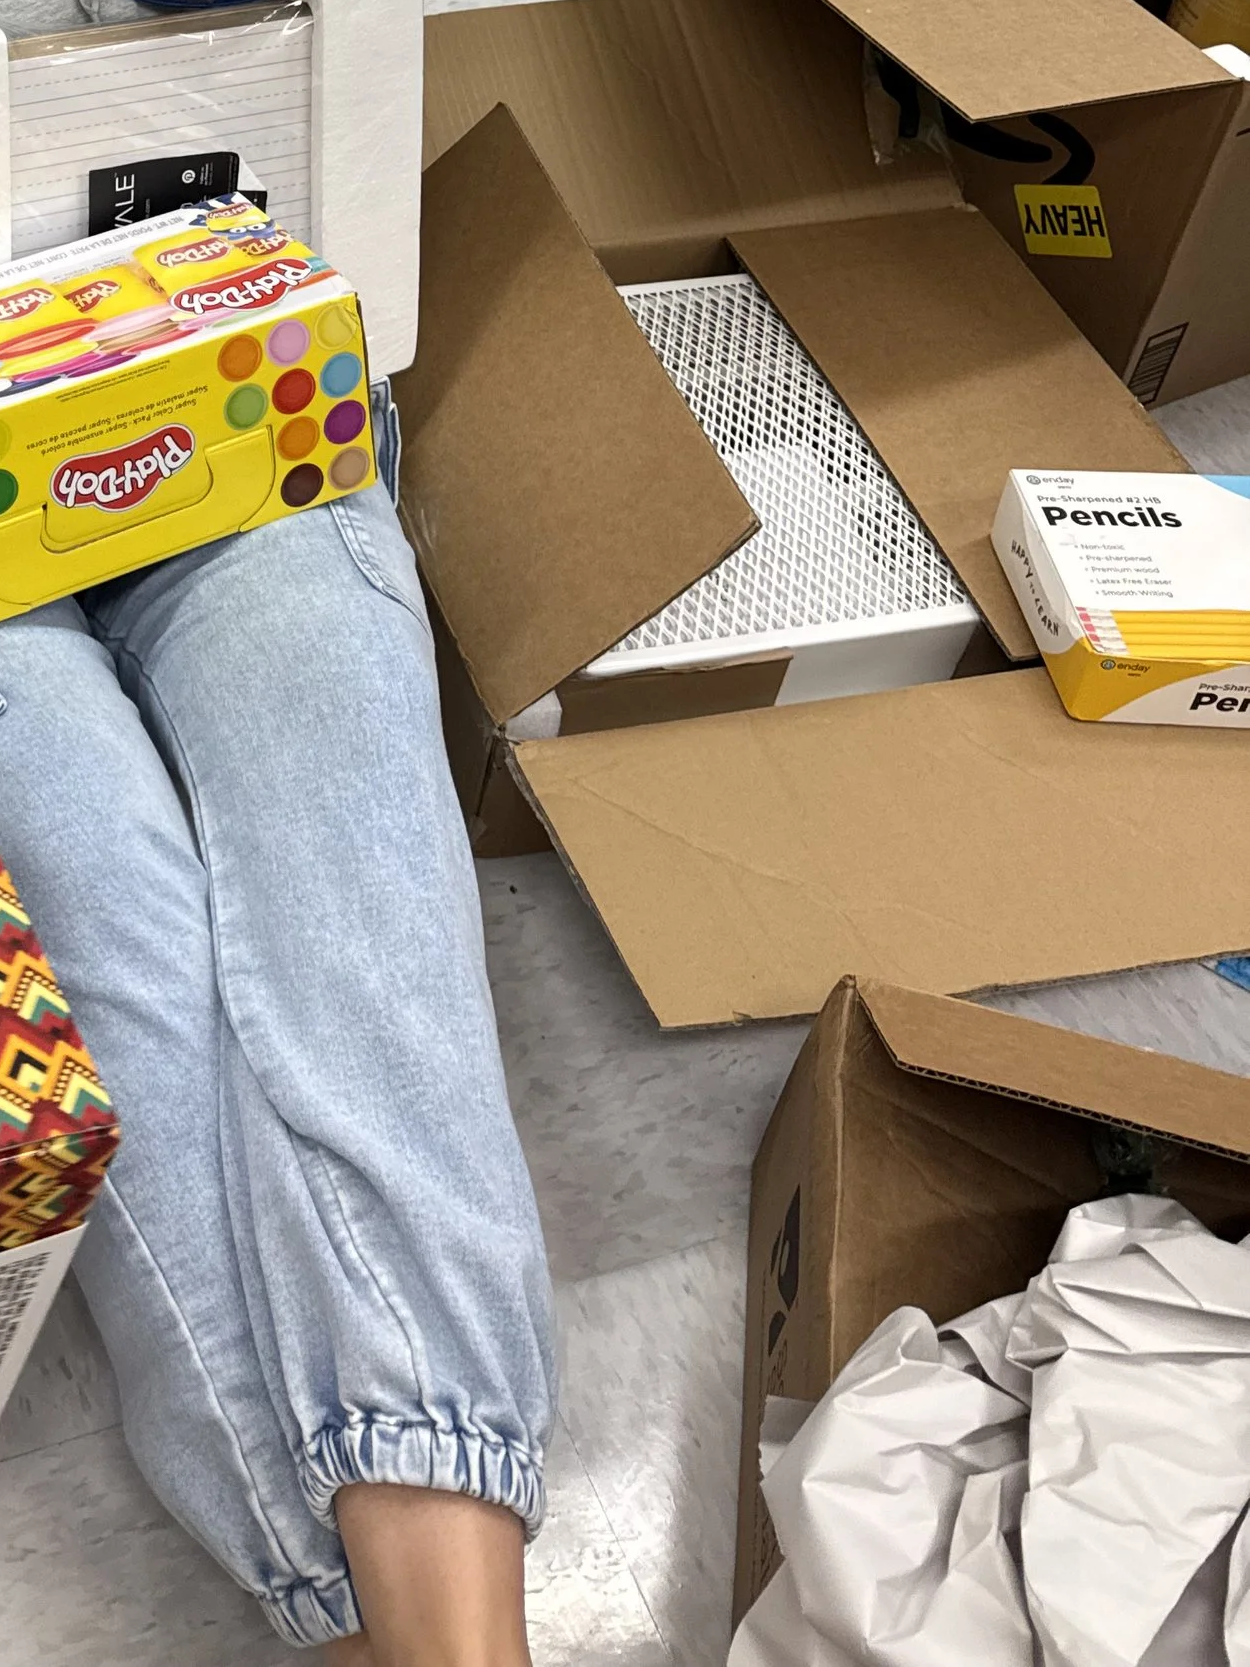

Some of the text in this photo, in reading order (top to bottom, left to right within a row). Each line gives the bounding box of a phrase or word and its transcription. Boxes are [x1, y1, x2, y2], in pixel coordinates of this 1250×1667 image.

[1023, 203, 1107, 238] HEAVY
[181, 263, 311, 314] Play-Doh
[145, 403, 155, 411] de
[175, 399, 197, 411] Super
[116, 405, 145, 420] colores
[151, 407, 174, 418] Color
[89, 417, 112, 431] Super
[132, 413, 151, 425] Pack
[105, 420, 128, 434] Super
[49, 434, 60, 443] de
[59, 434, 194, 508] Play-Doh
[1042, 475, 1075, 485] enday
[1037, 495, 1161, 505] Pre-Sharpened #2 HB
[1041, 506, 1183, 528] Pencils
[1080, 543, 1126, 551] Non-toxic
[1086, 554, 1153, 563] Pre-sharpened
[1091, 566, 1160, 574] Premium wood
[1010, 539, 1059, 637] HAPPY LEARN
[1123, 578, 1142, 586] Free
[1145, 578, 1172, 586] Eraser
[1101, 589, 1174, 598] Smooth Writing
[1116, 662, 1151, 674] enday
